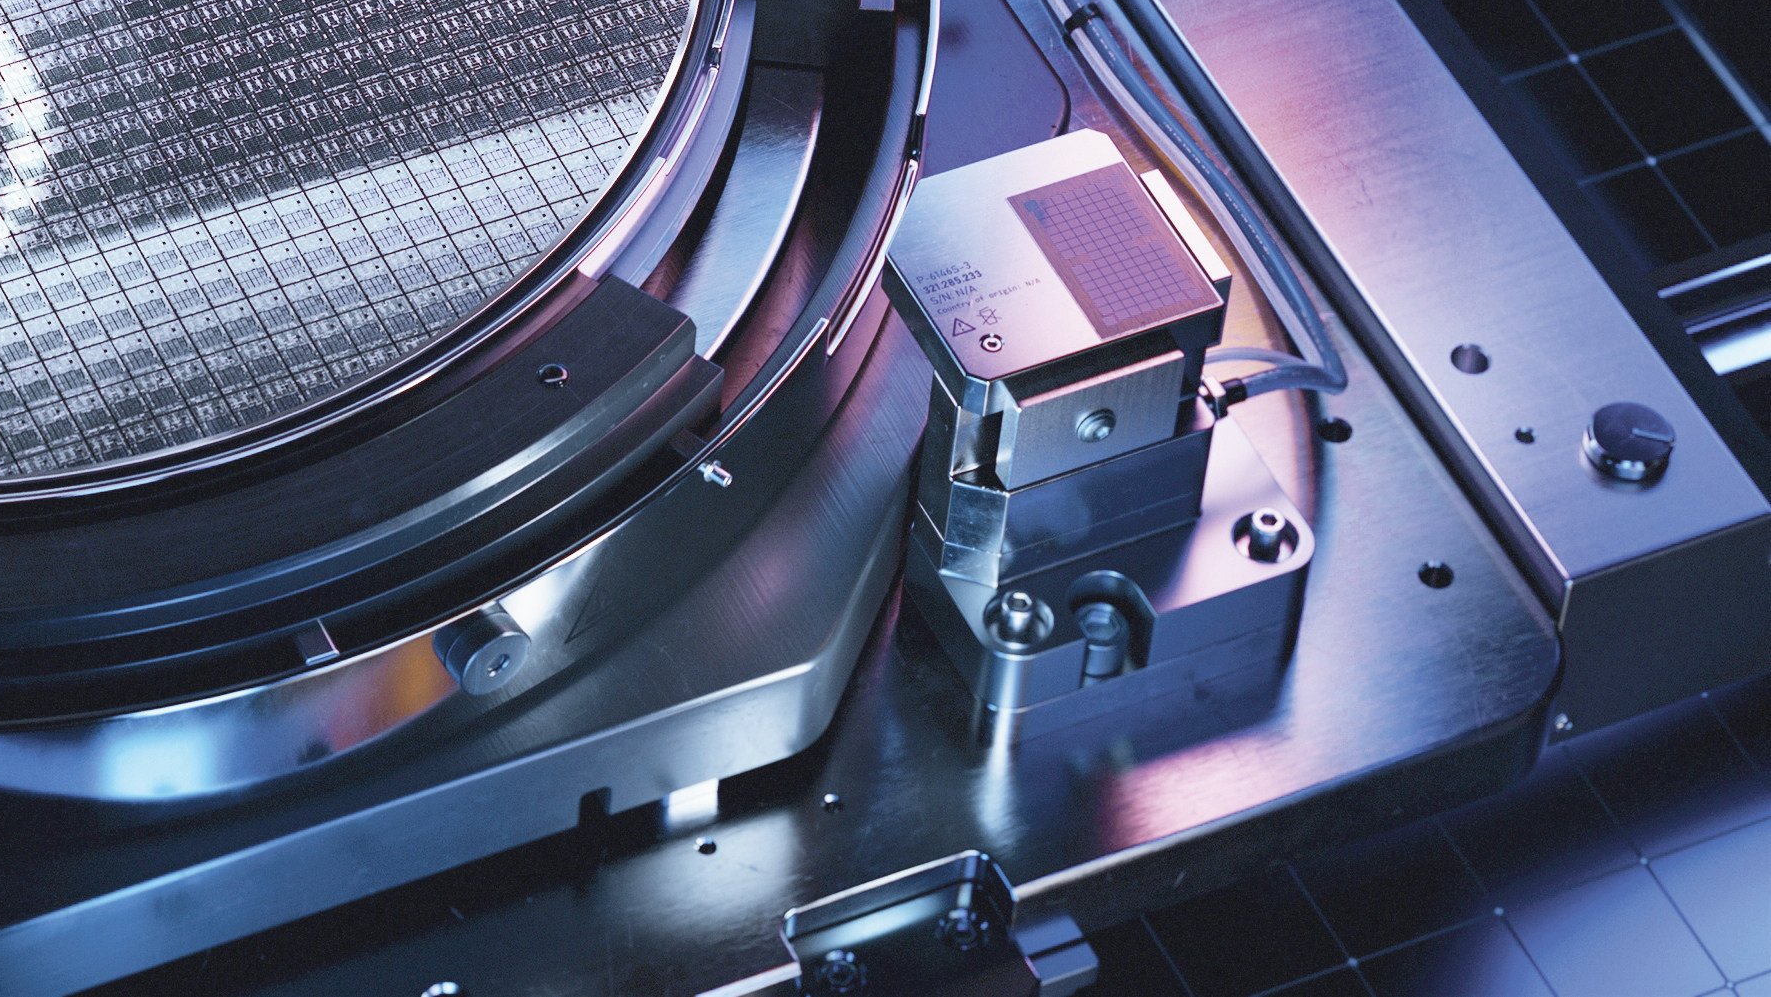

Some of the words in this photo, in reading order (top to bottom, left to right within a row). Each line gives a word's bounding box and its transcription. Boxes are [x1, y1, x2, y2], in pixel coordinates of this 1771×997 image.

[923, 270, 982, 294] 321.285.233
[955, 285, 978, 297] N/A
[937, 301, 971, 314] Country
[975, 295, 984, 303] of
[1025, 277, 1041, 286] N/A
